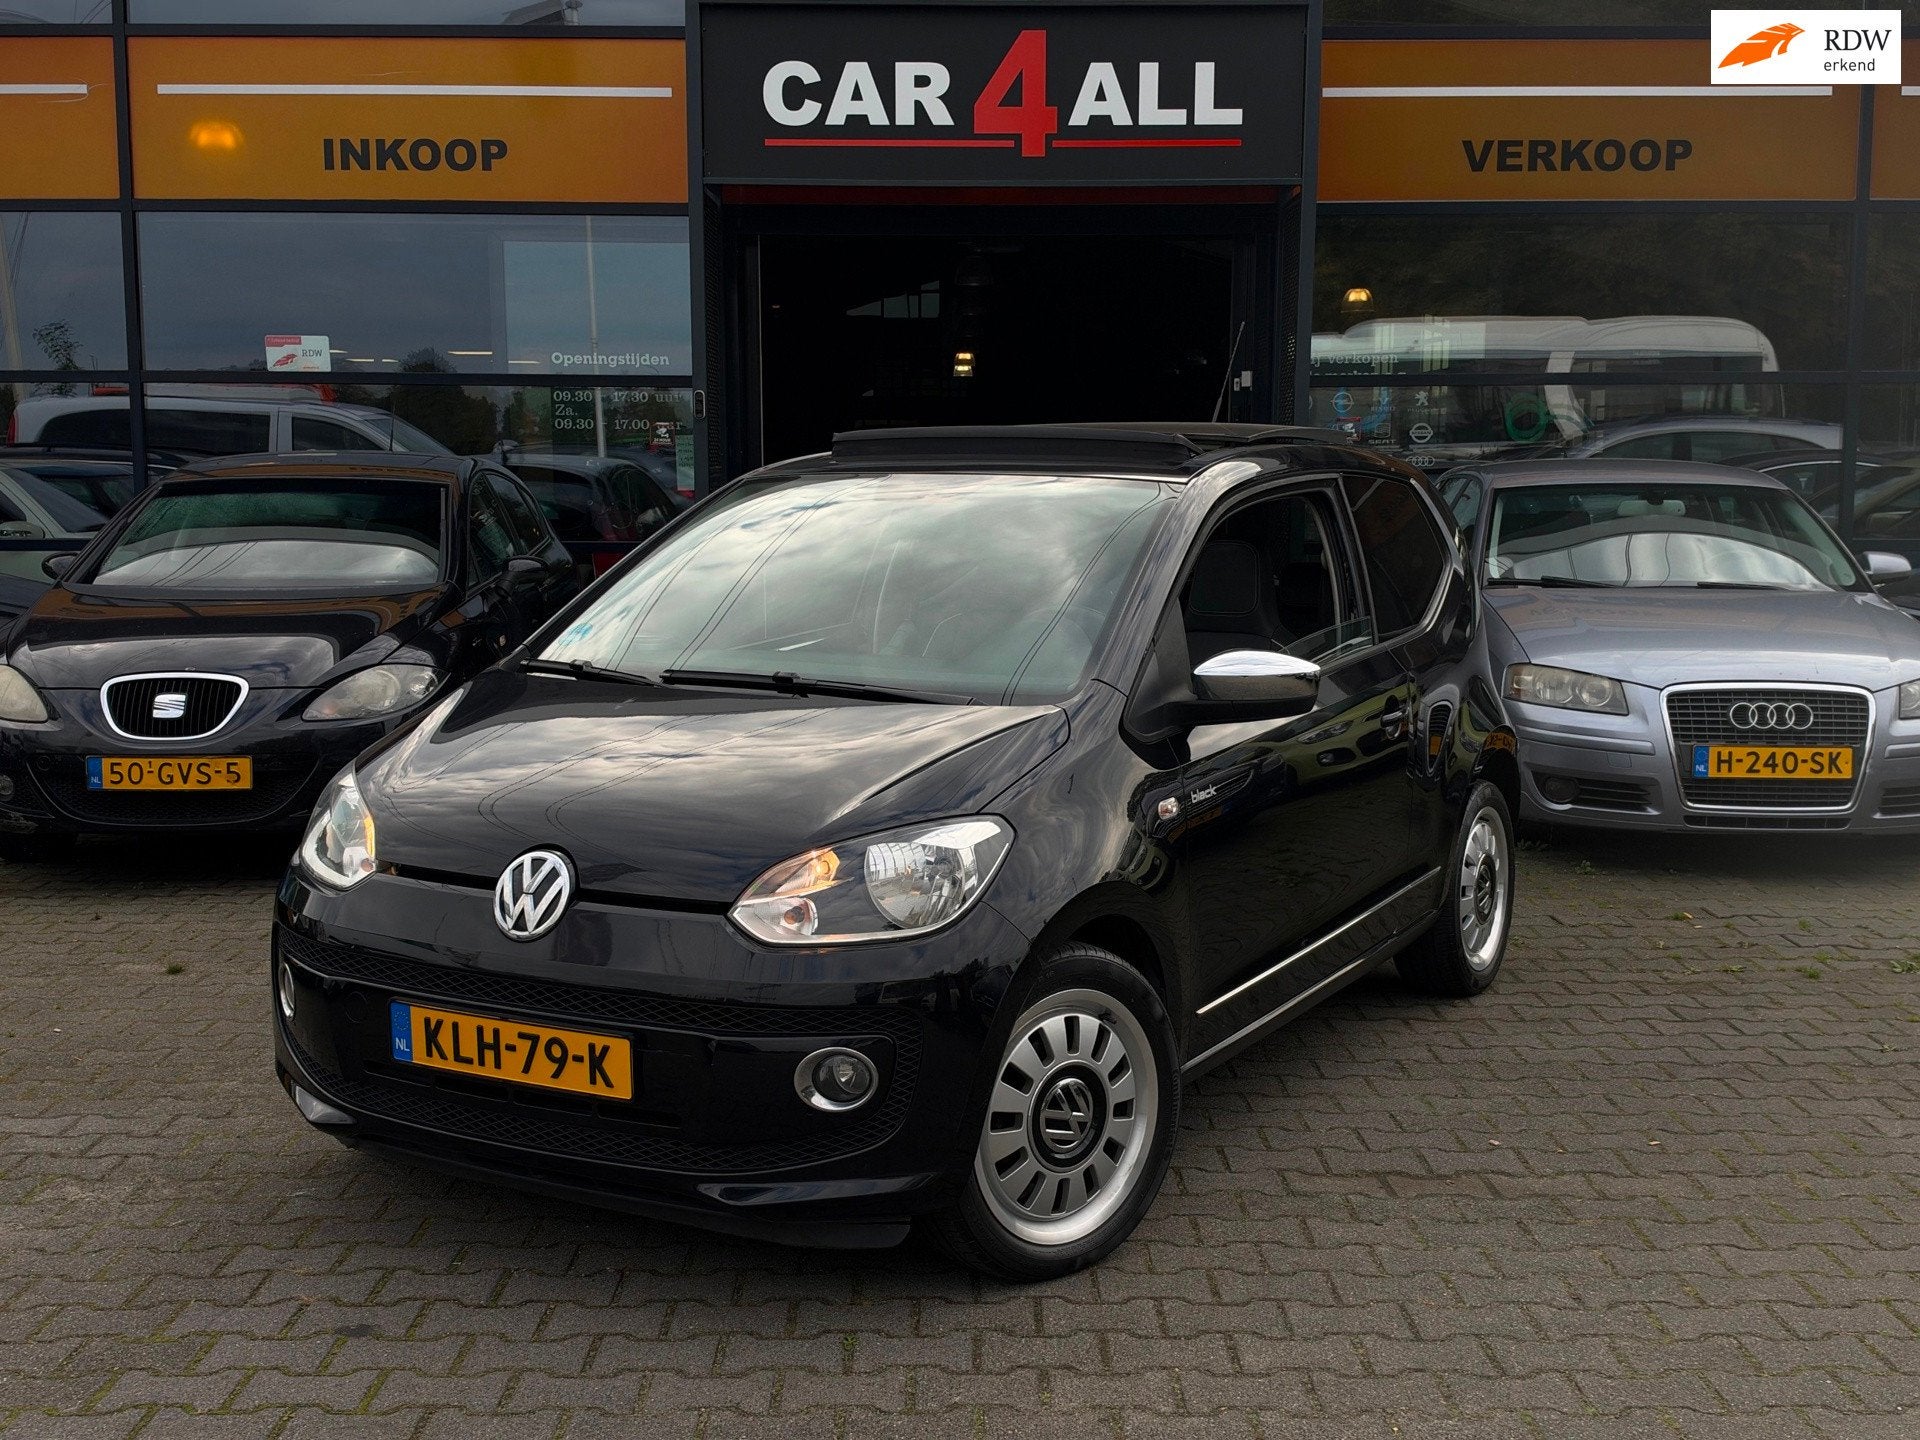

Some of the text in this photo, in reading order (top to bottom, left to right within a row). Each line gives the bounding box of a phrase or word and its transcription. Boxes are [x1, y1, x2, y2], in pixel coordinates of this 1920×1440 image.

[762, 29, 1244, 157] CAR 4 ALL
[321, 138, 509, 172] INKOOP
[1461, 138, 1694, 172] VERKOOP
[302, 349, 323, 357] RDW
[551, 351, 670, 368] Openingstijden
[1327, 352, 1400, 367] verkopen
[553, 390, 593, 402] 09.30
[612, 391, 649, 403] 17.30
[555, 404, 578, 416] Za.
[554, 419, 594, 430] 09.30
[614, 419, 650, 430] 17.00
[1695, 764, 1707, 772] NL
[1716, 751, 1842, 774] H-240-SK
[90, 776, 101, 784] NL
[1190, 783, 1217, 803] black
[395, 1037, 410, 1052] NL
[423, 1015, 615, 1089] KLH-79-K
